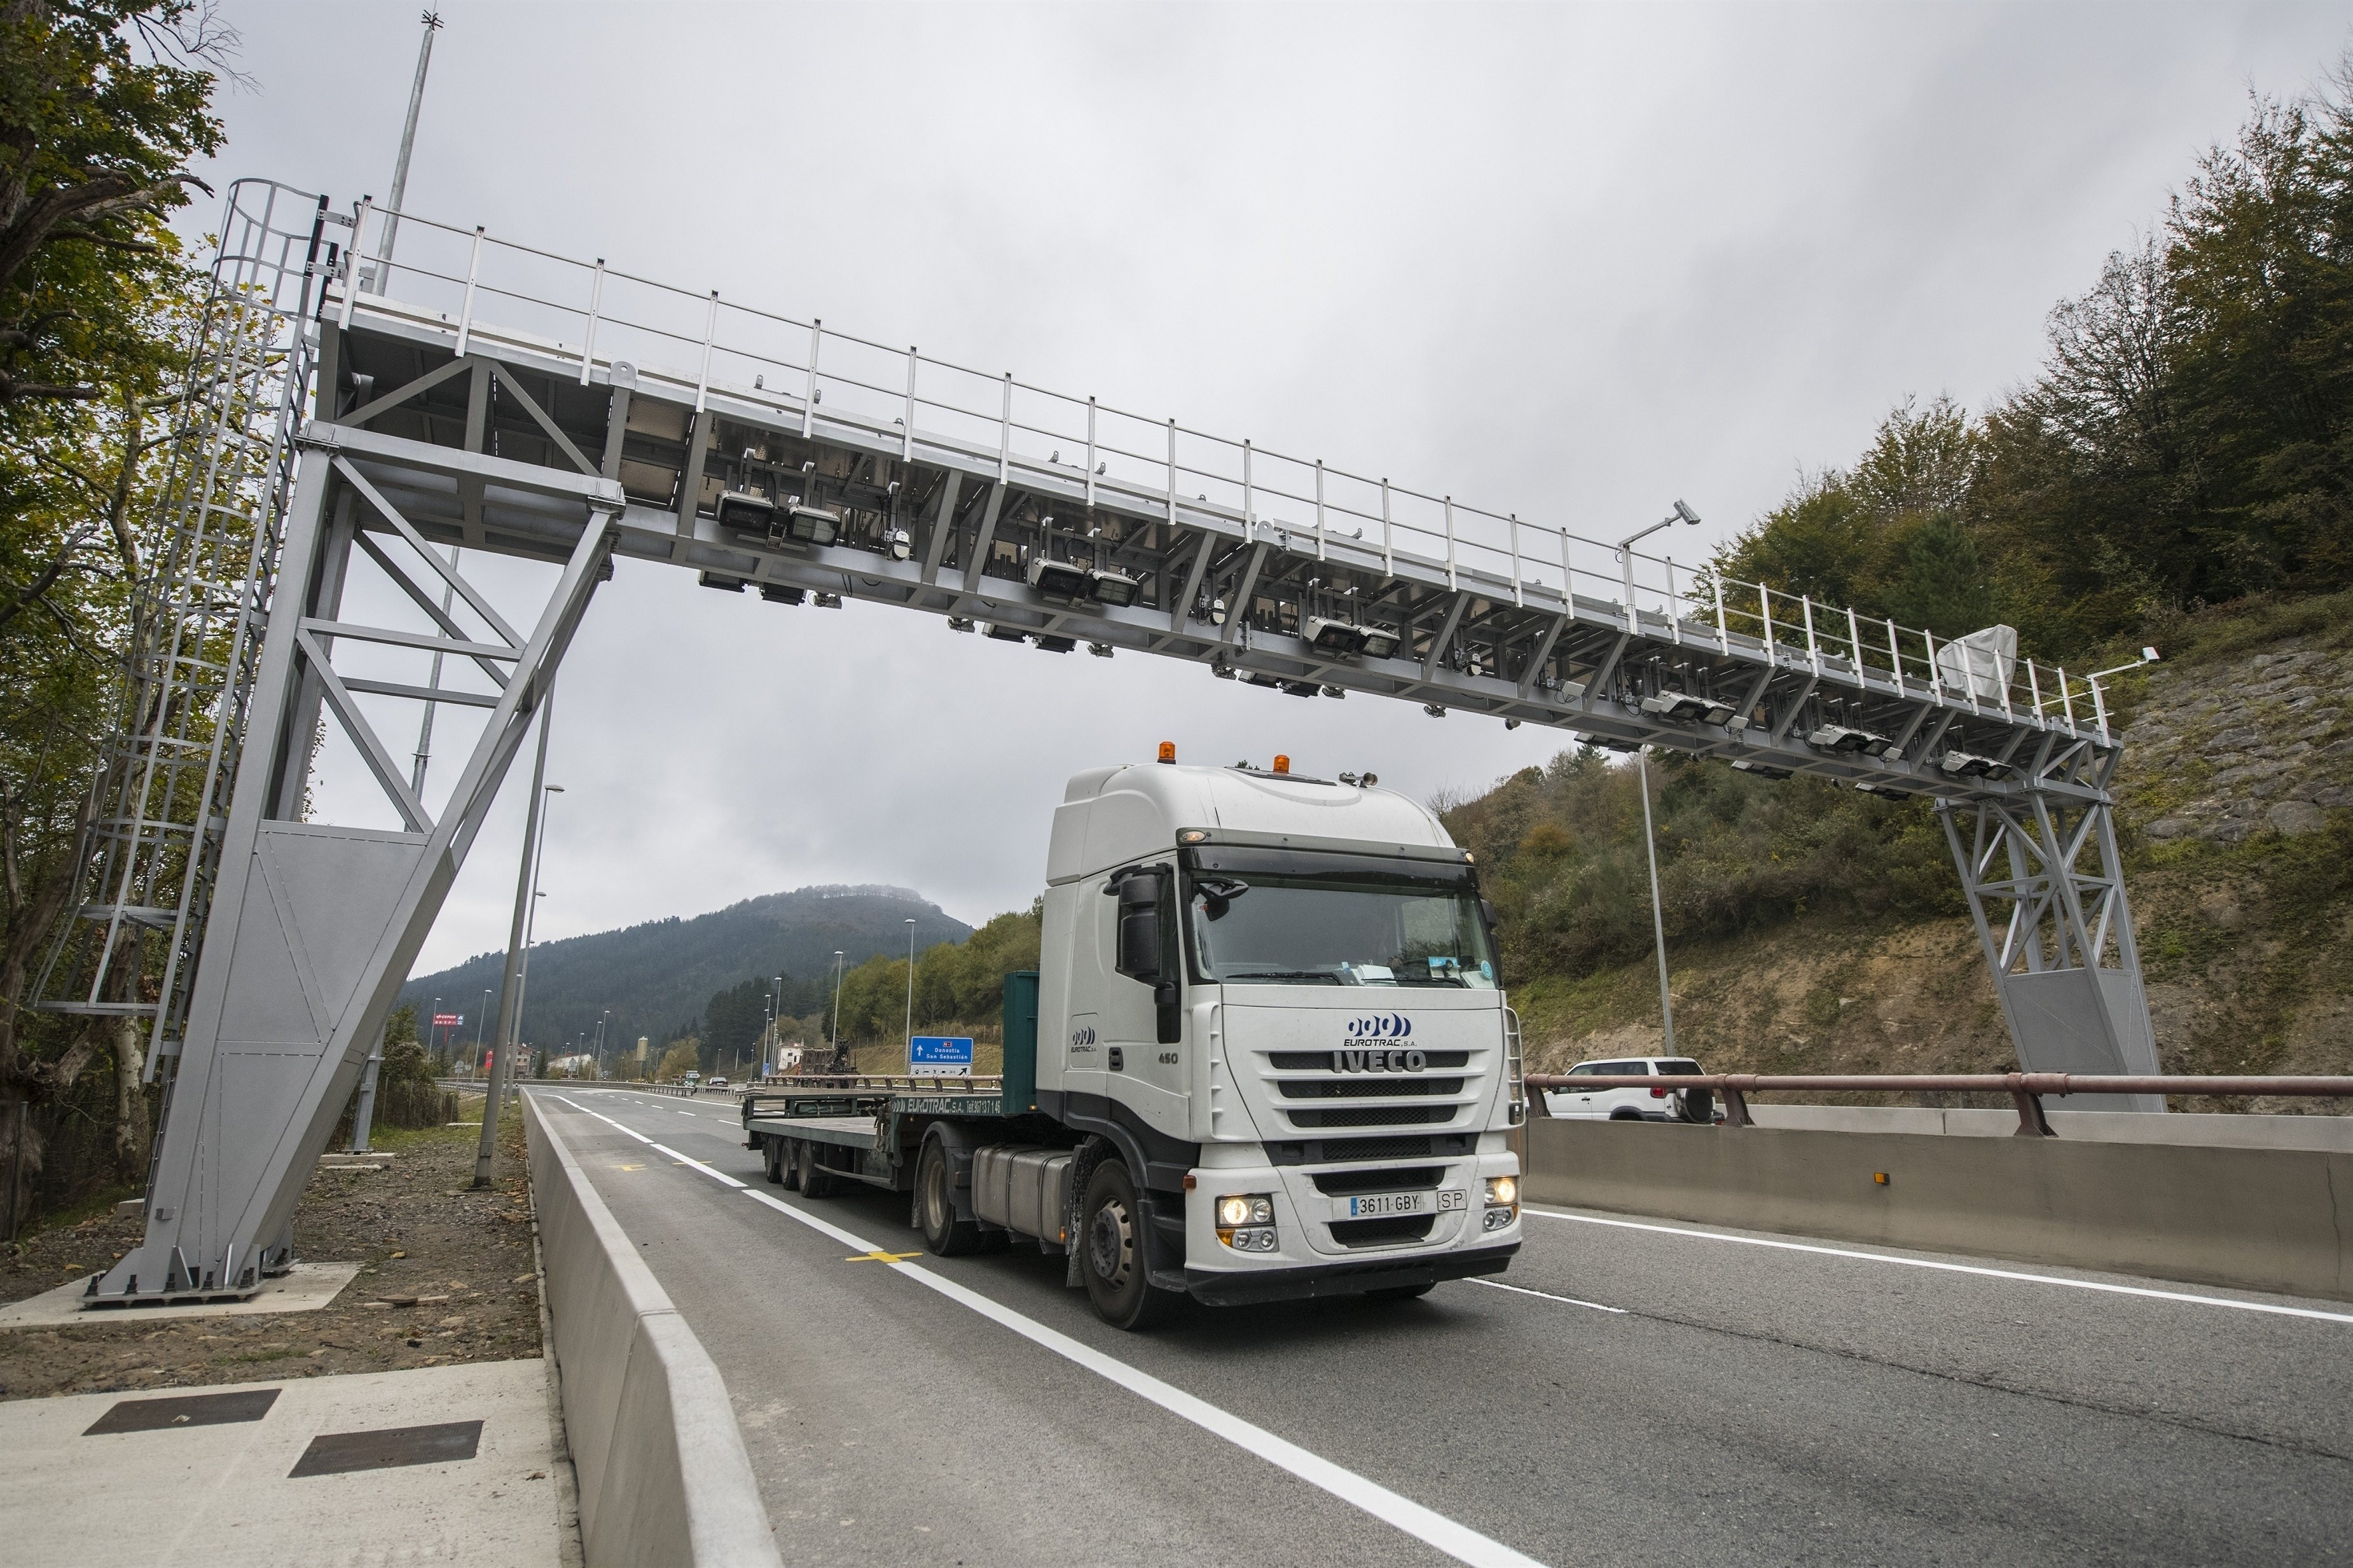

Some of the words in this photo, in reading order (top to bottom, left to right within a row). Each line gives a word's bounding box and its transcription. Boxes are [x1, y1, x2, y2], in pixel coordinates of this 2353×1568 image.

[1158, 1053, 1178, 1064] 450
[1334, 1050, 1426, 1073] IVECO
[1360, 1197, 1390, 1213] 3611
[1395, 1195, 1418, 1211] GBY
